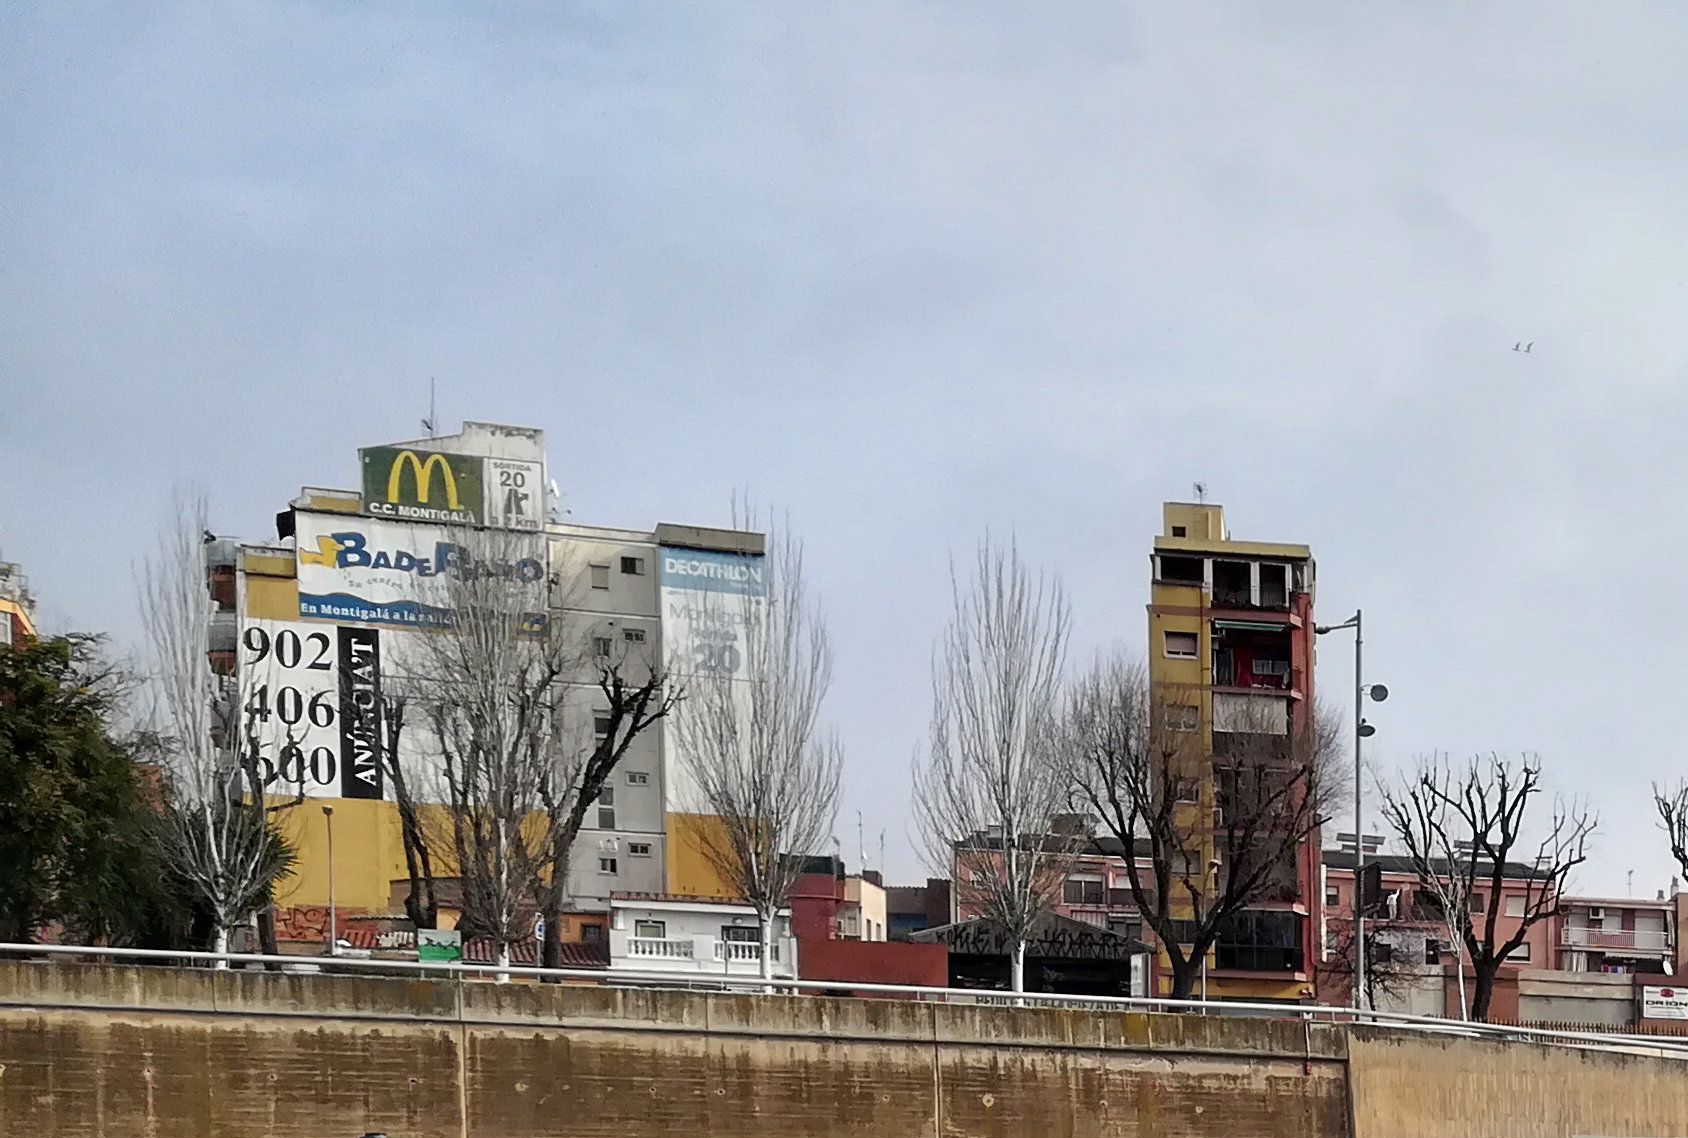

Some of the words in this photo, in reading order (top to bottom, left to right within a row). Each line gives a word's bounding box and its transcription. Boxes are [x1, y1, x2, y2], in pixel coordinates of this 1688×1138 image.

[500, 470, 525, 488] 20
[369, 502, 396, 515] C.C.
[664, 557, 761, 583] DECATHLON
[301, 602, 317, 614] En
[320, 604, 390, 620] Montigalá
[392, 611, 401, 620] a
[403, 610, 416, 621] la
[243, 627, 333, 670] 902
[245, 684, 335, 728] 406
